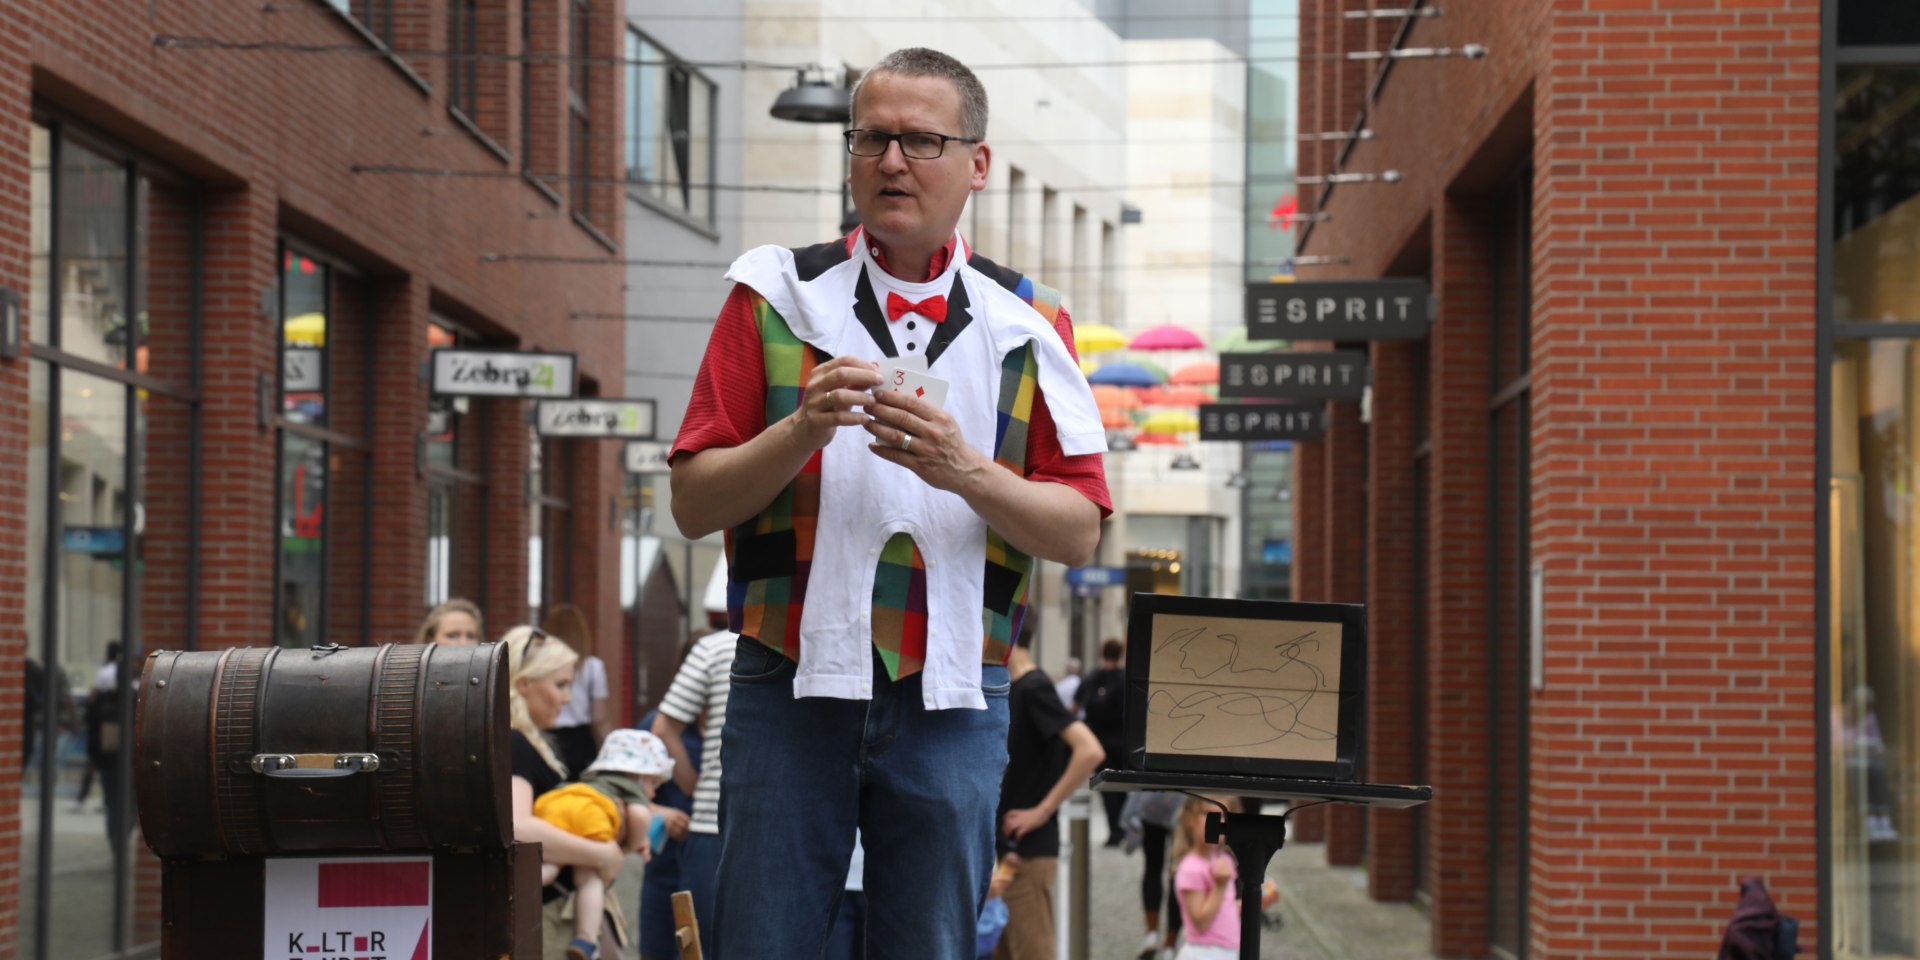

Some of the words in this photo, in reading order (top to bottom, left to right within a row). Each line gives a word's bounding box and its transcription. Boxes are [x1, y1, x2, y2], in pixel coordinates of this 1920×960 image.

[1258, 297, 1412, 324] ESPRIT
[893, 370, 905, 386] 3
[1227, 363, 1353, 386] ESPRIT
[1205, 411, 1312, 433] ESPRIT
